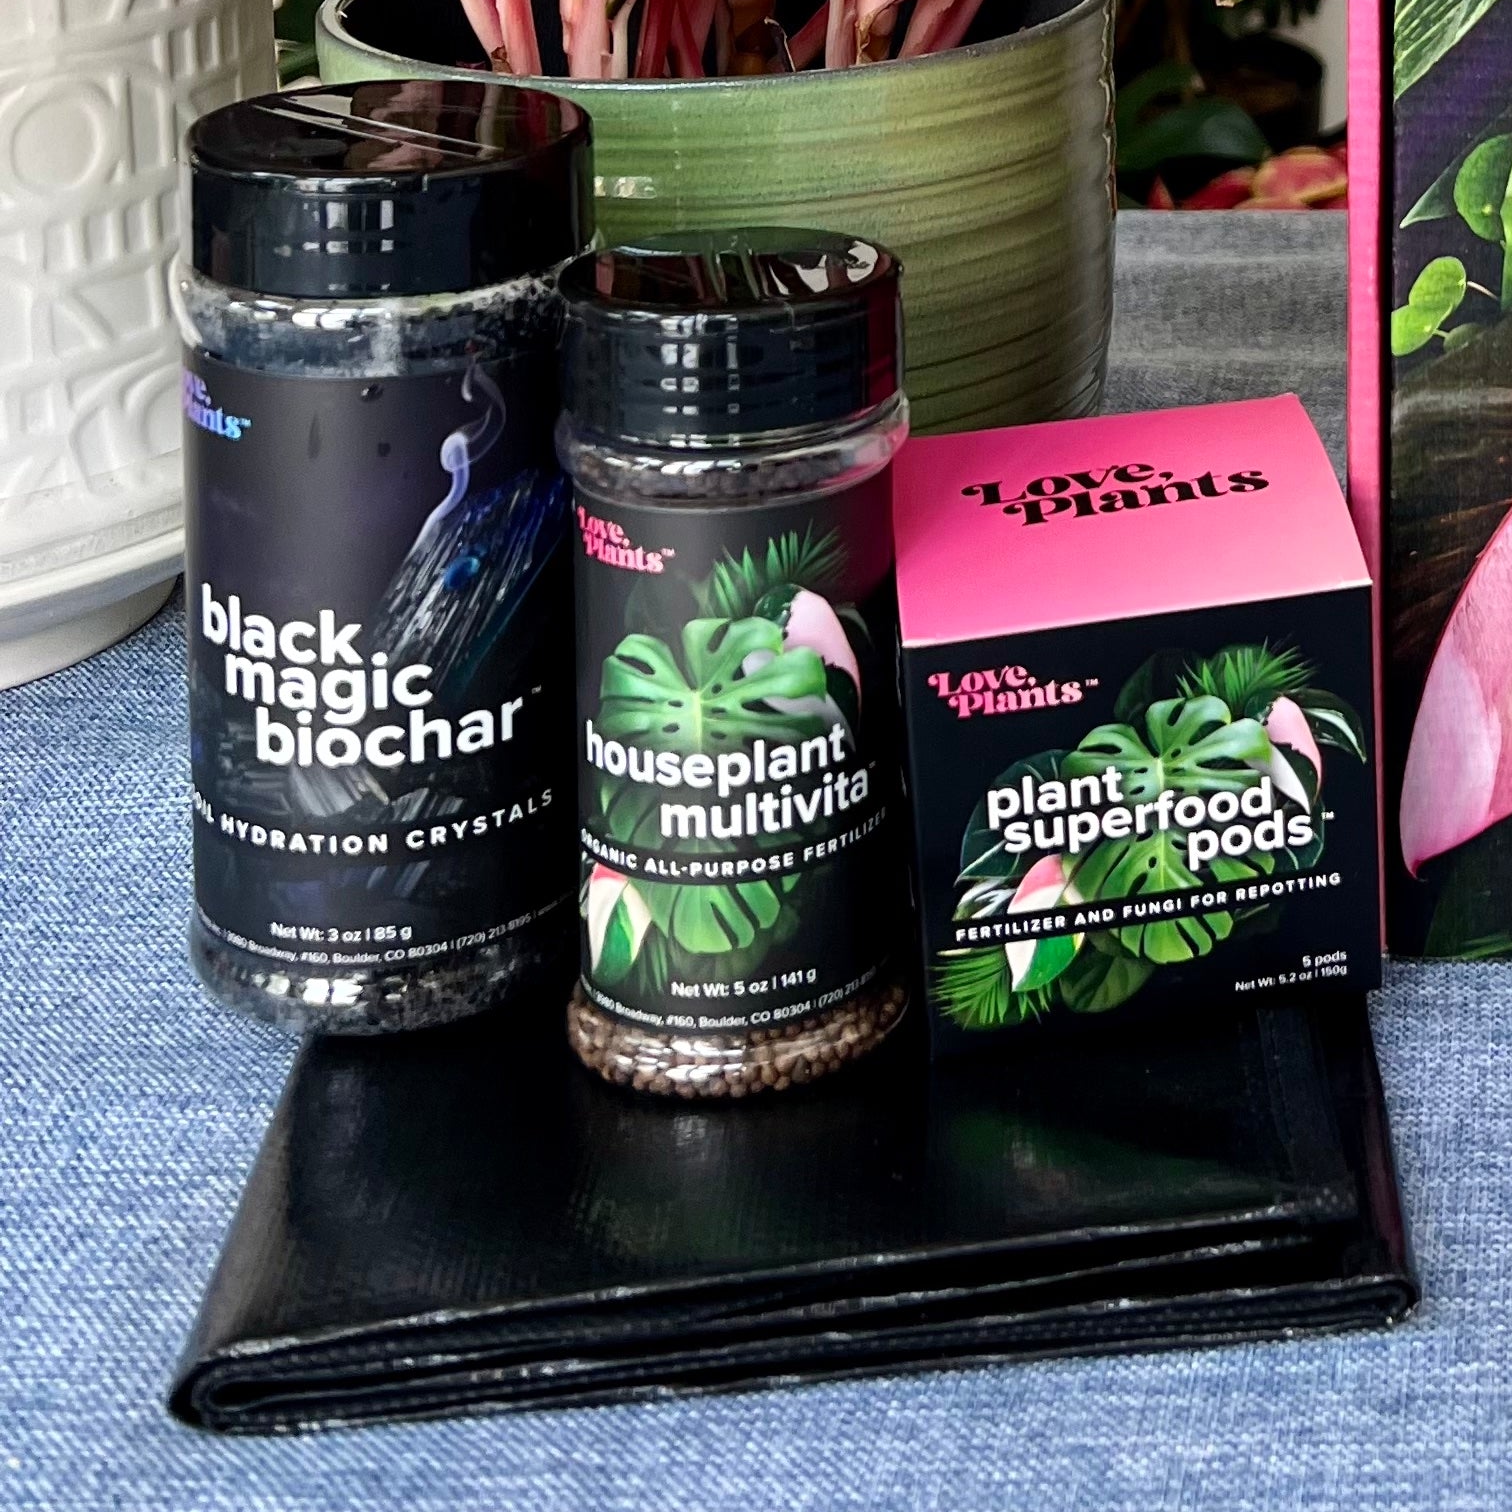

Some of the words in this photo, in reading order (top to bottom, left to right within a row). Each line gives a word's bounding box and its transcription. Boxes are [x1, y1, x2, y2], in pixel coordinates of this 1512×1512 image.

[960, 462, 1174, 507] Love,
[1003, 470, 1269, 527] Plants
[201, 583, 363, 666] black
[225, 652, 434, 726] magic
[927, 665, 1037, 699] Love,
[586, 720, 846, 797] houseplant
[220, 813, 389, 856] HYDRATION
[405, 789, 552, 850] CRYSTALS
[660, 768, 869, 839] multivita
[986, 765, 1124, 830] plant
[1003, 776, 1272, 854] superfood
[644, 851, 795, 878] ALL-PURPOSE
[270, 921, 298, 939] Net
[327, 927, 339, 942] 3
[341, 930, 362, 943] oz
[373, 926, 397, 941] 85
[400, 926, 412, 941] g
[956, 915, 1067, 943] FERTILIZER
[1075, 908, 1115, 926] AND
[1123, 897, 1183, 919] FUNGI
[1191, 890, 1227, 909] FOR
[1236, 871, 1342, 901] REPOTTING
[384, 948, 406, 961] CO
[407, 941, 448, 959] 80304
[456, 931, 486, 951] (720)
[1315, 950, 1347, 967] pods
[671, 981, 700, 998] Net
[733, 980, 746, 996] 5
[749, 979, 769, 995] oz
[780, 970, 803, 988] 141
[806, 968, 817, 983] g
[750, 1009, 771, 1025] CO
[773, 1000, 811, 1020] 80304
